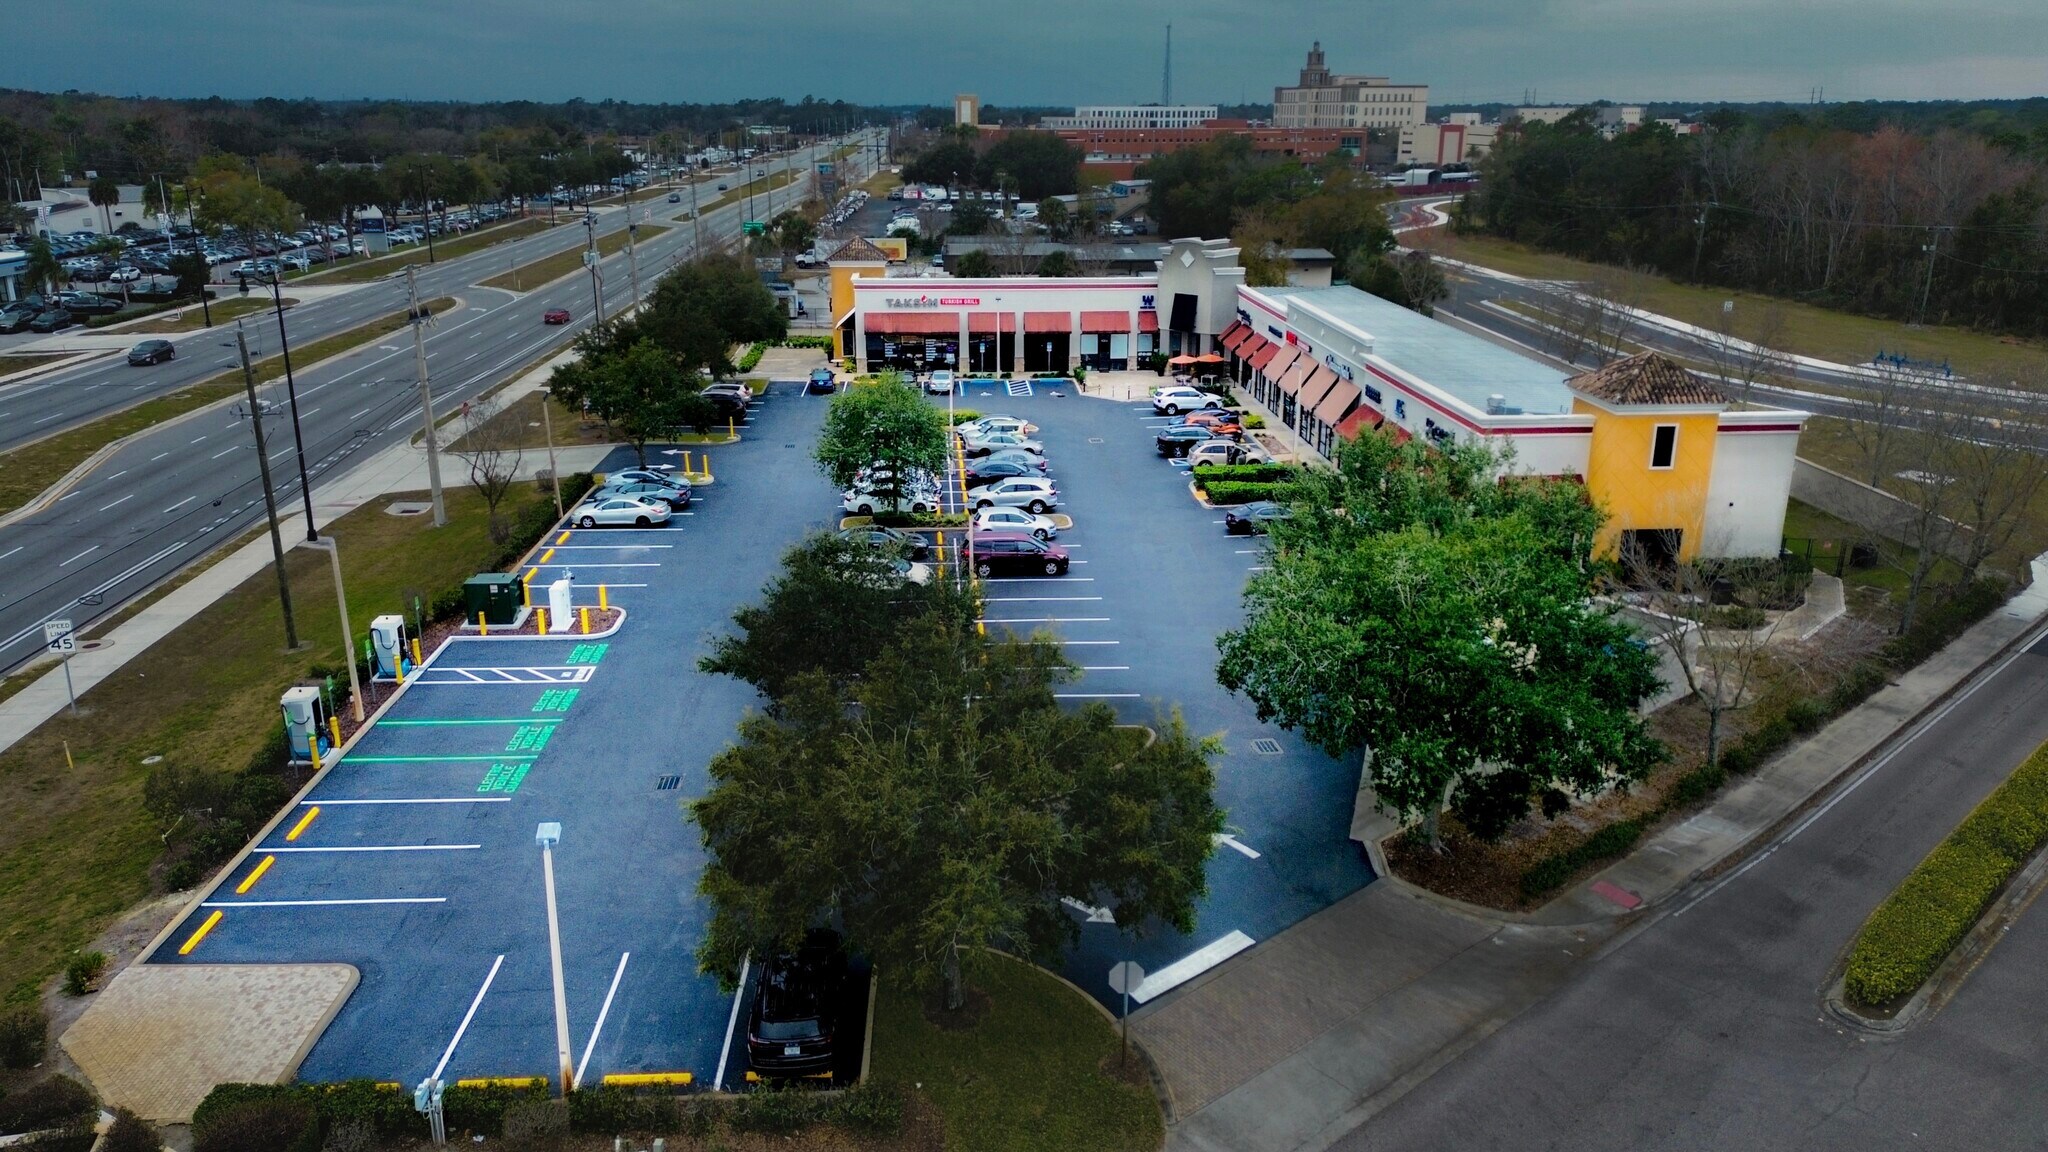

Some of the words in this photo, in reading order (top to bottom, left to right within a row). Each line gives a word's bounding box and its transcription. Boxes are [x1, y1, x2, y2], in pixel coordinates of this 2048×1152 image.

[51, 639, 73, 650] 45
[477, 763, 503, 792] ELECTRIC
[491, 765, 516, 791] VEHICLE
